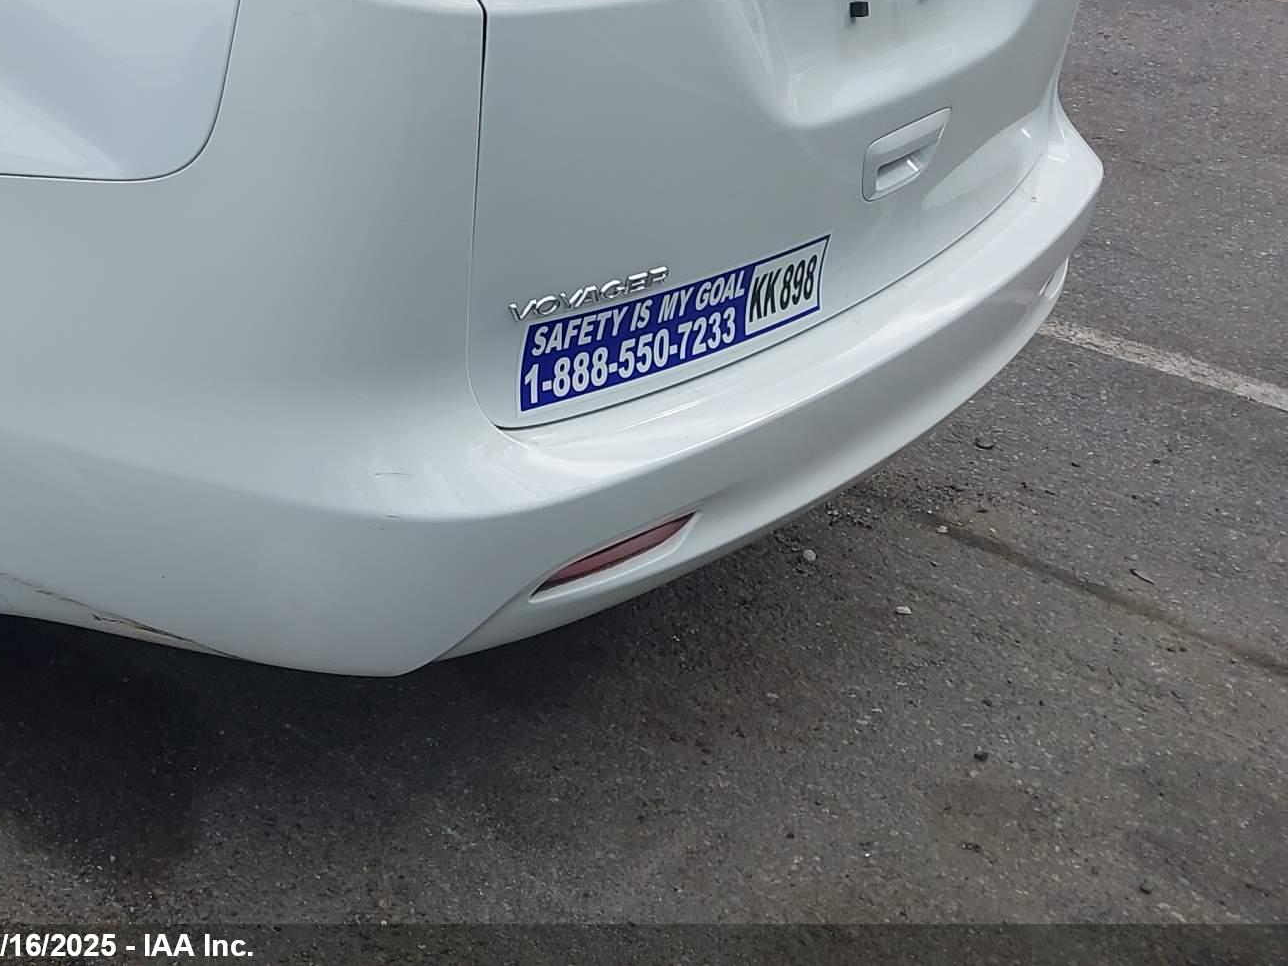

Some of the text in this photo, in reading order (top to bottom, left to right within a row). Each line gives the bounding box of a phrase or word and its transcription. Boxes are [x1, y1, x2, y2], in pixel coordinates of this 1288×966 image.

[508, 265, 670, 322] VOYAGER
[531, 270, 746, 356] SAFETY IS MY GOAL
[524, 307, 737, 404] 1-888-550-7233
